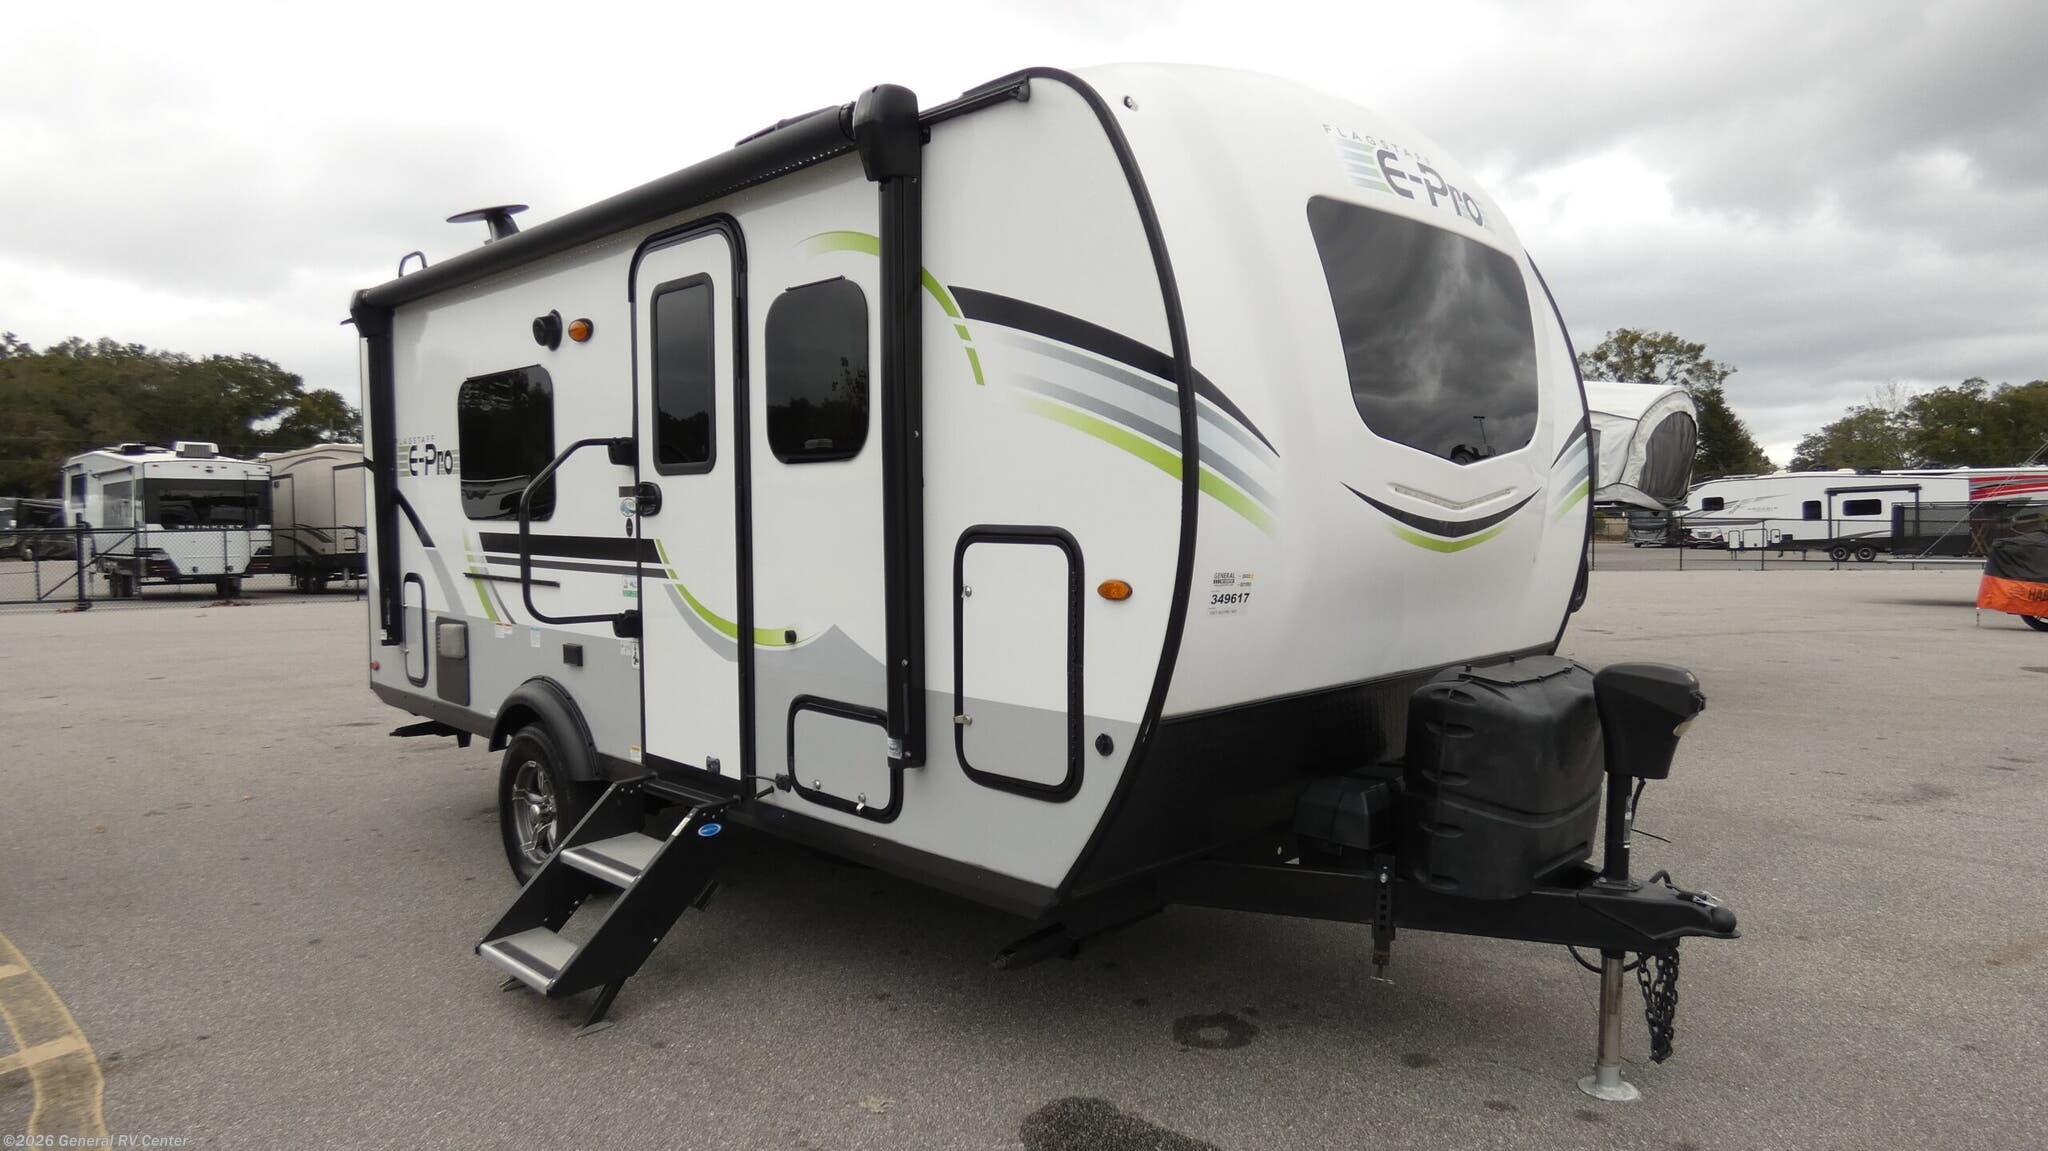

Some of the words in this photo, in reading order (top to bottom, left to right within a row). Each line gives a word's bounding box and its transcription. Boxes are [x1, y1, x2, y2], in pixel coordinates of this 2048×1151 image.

[1322, 123, 1431, 164] FLAGSTAFF
[1376, 149, 1483, 227] E-Pro
[409, 443, 453, 476] E-Pro
[1210, 592, 1250, 605] 349617
